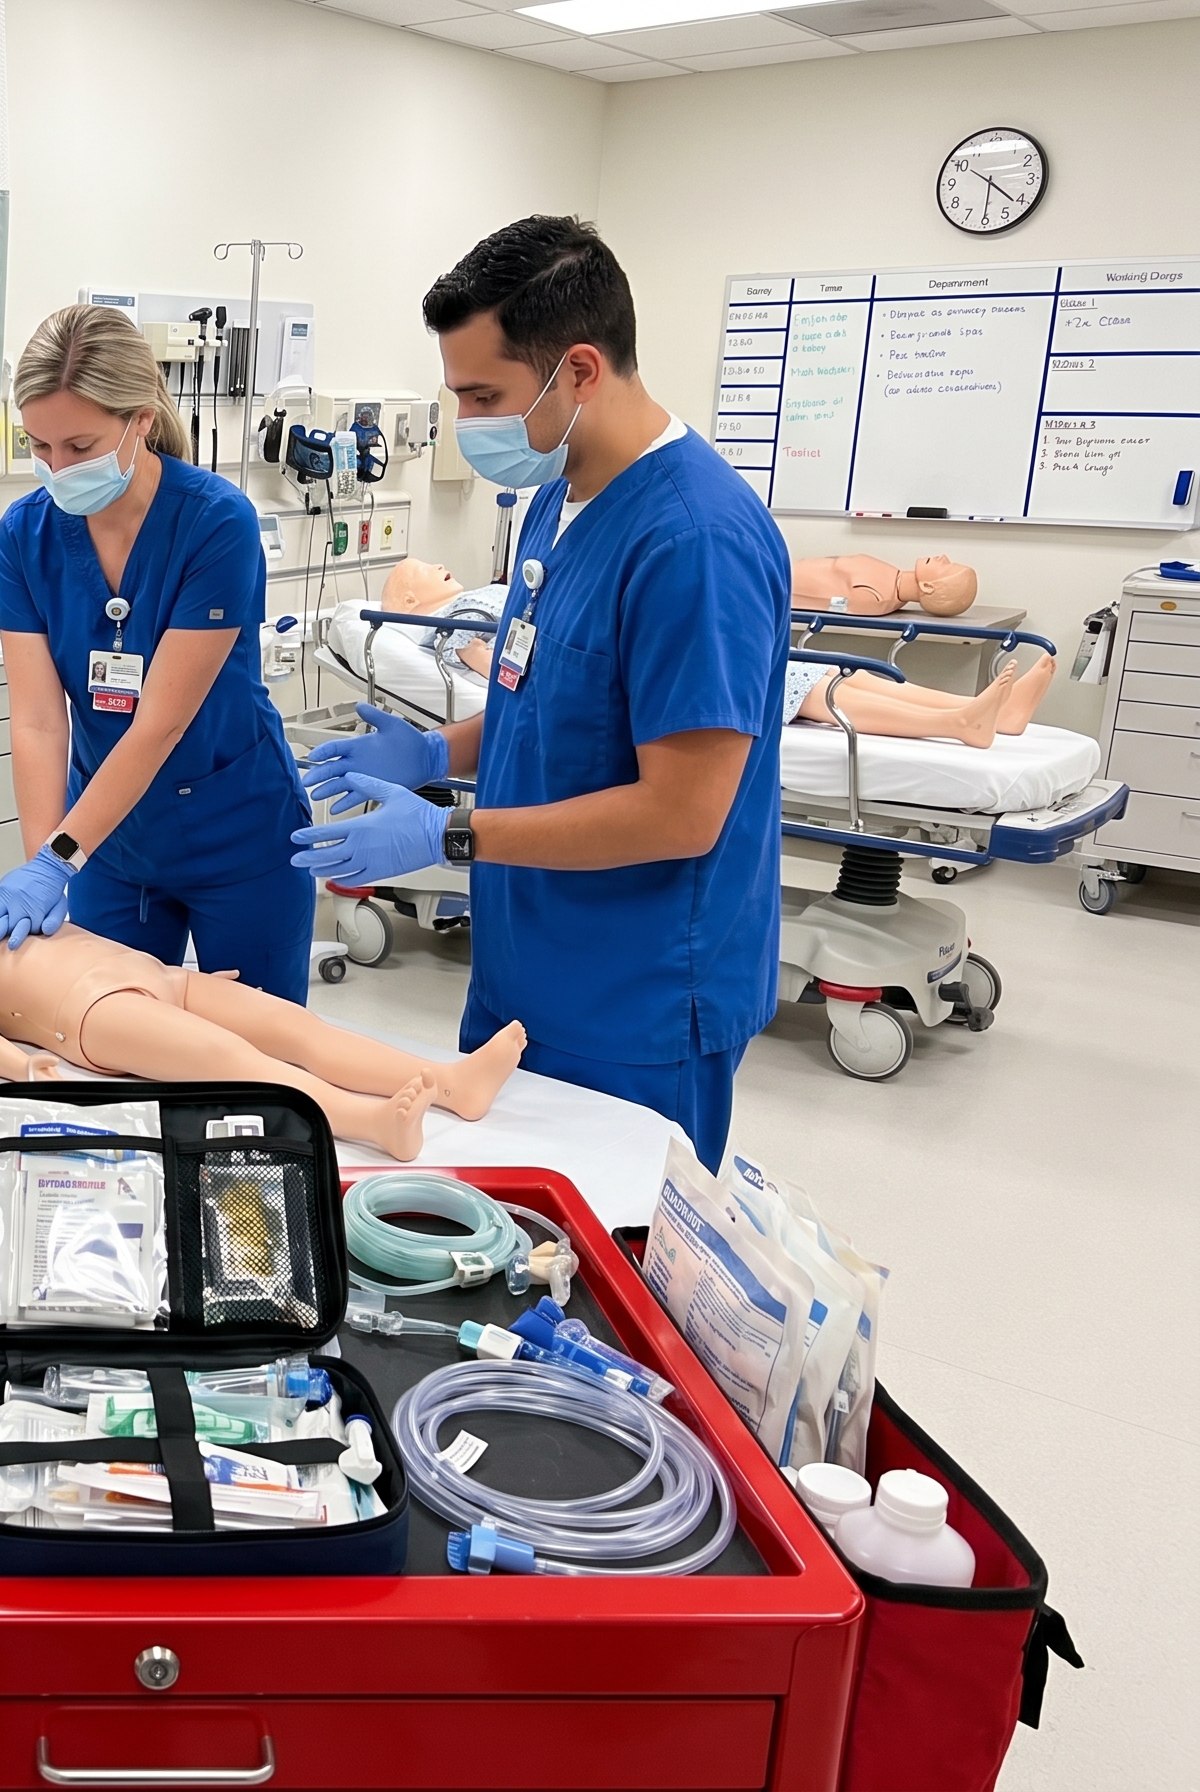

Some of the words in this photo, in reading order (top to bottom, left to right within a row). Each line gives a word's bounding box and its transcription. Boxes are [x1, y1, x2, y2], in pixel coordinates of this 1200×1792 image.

[954, 159, 969, 172] 10
[1023, 154, 1033, 168] 2
[947, 178, 957, 191] 9
[1026, 172, 1036, 186] 3
[950, 196, 960, 209] 8
[1015, 193, 1025, 205] 4
[965, 208, 974, 221] 7
[1000, 207, 1010, 220] 5
